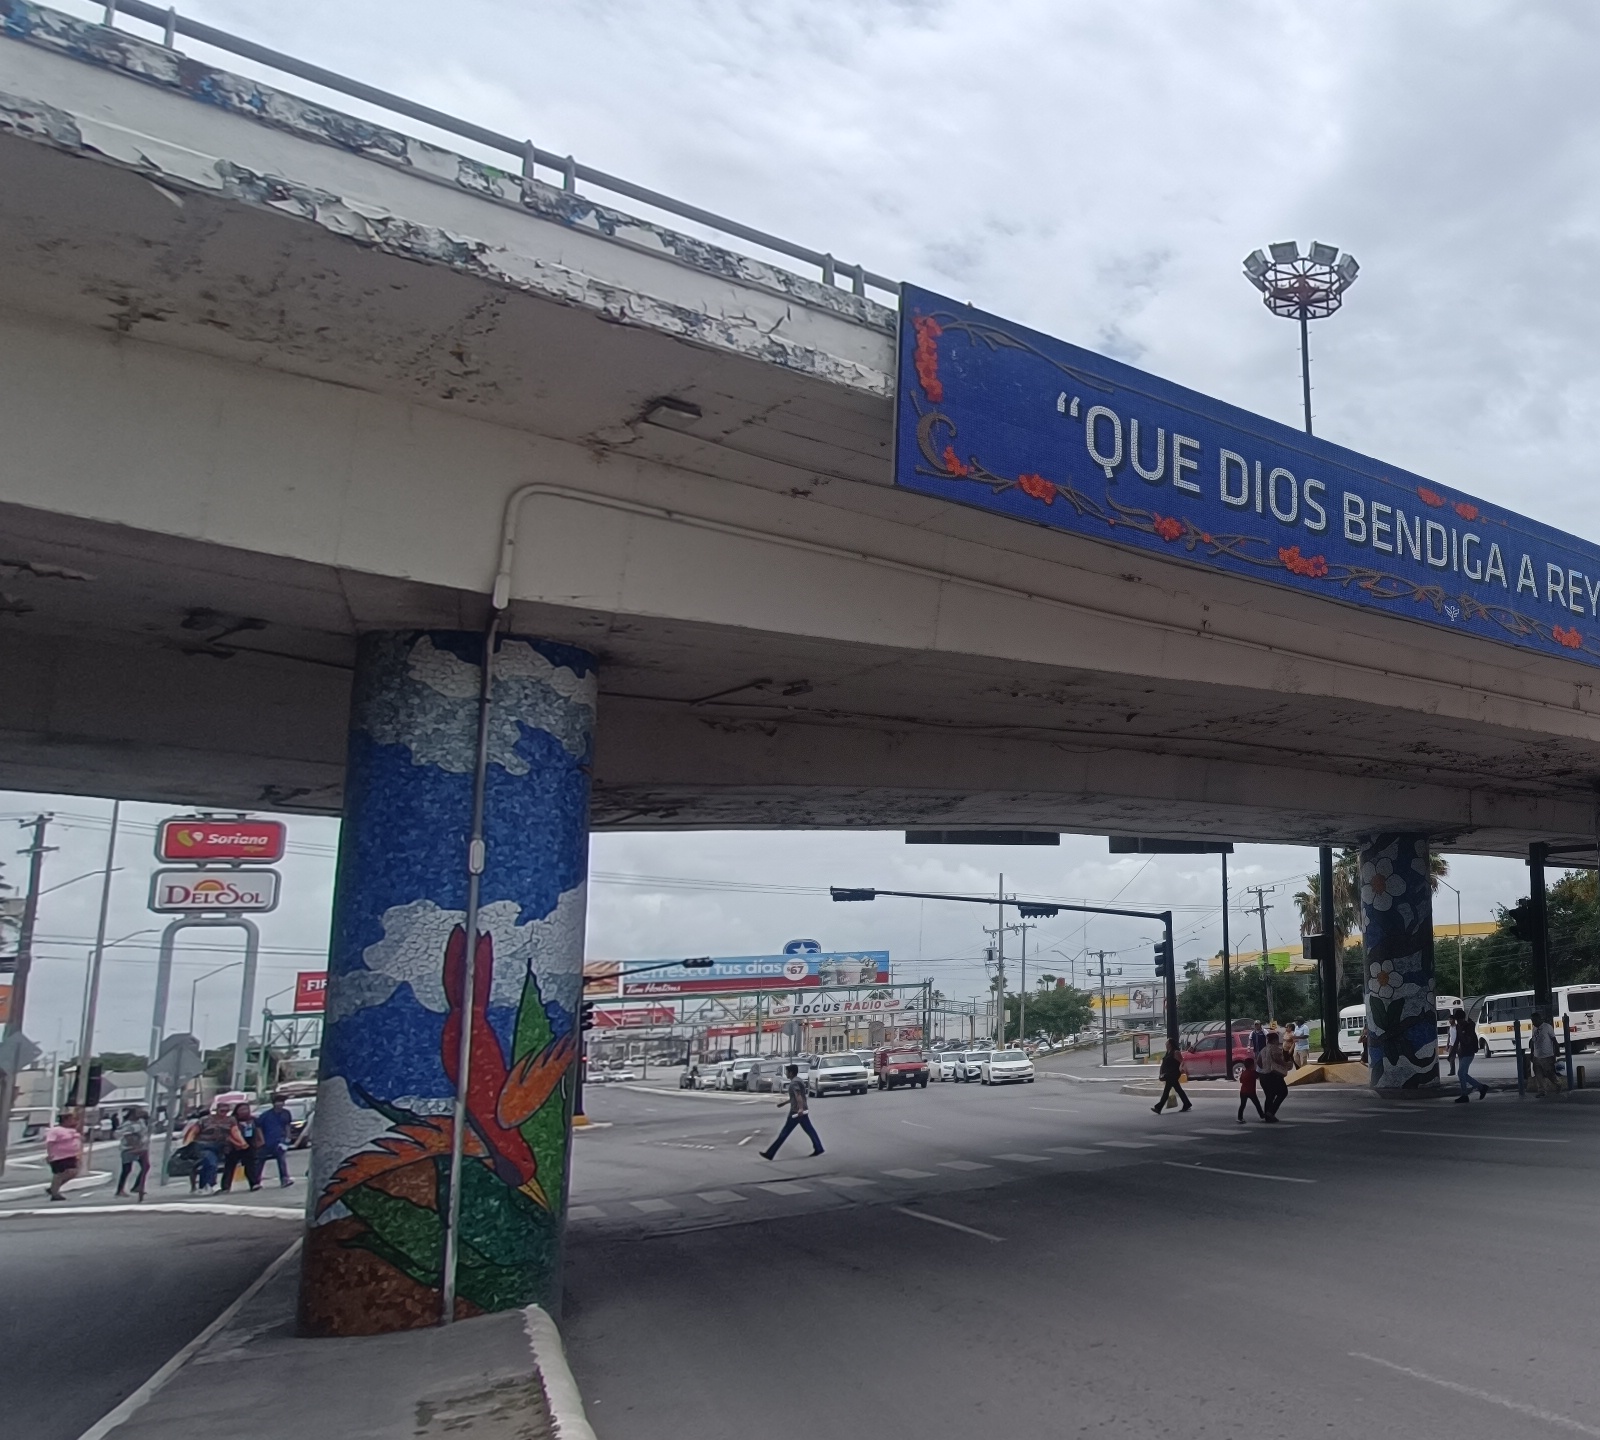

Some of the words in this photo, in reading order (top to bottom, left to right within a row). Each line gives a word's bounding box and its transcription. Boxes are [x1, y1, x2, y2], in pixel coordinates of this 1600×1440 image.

[1220, 447, 1326, 531] DIOS
[1343, 490, 1508, 589] BENDIGA
[1516, 553, 1539, 599] A
[207, 832, 269, 845] Soriana
[714, 962, 742, 976] tus
[745, 959, 782, 974] días
[626, 984, 643, 994] Tim
[644, 983, 681, 993] Hortons
[792, 1002, 841, 1014] FOCUS
[843, 1000, 882, 1011] RADIO
